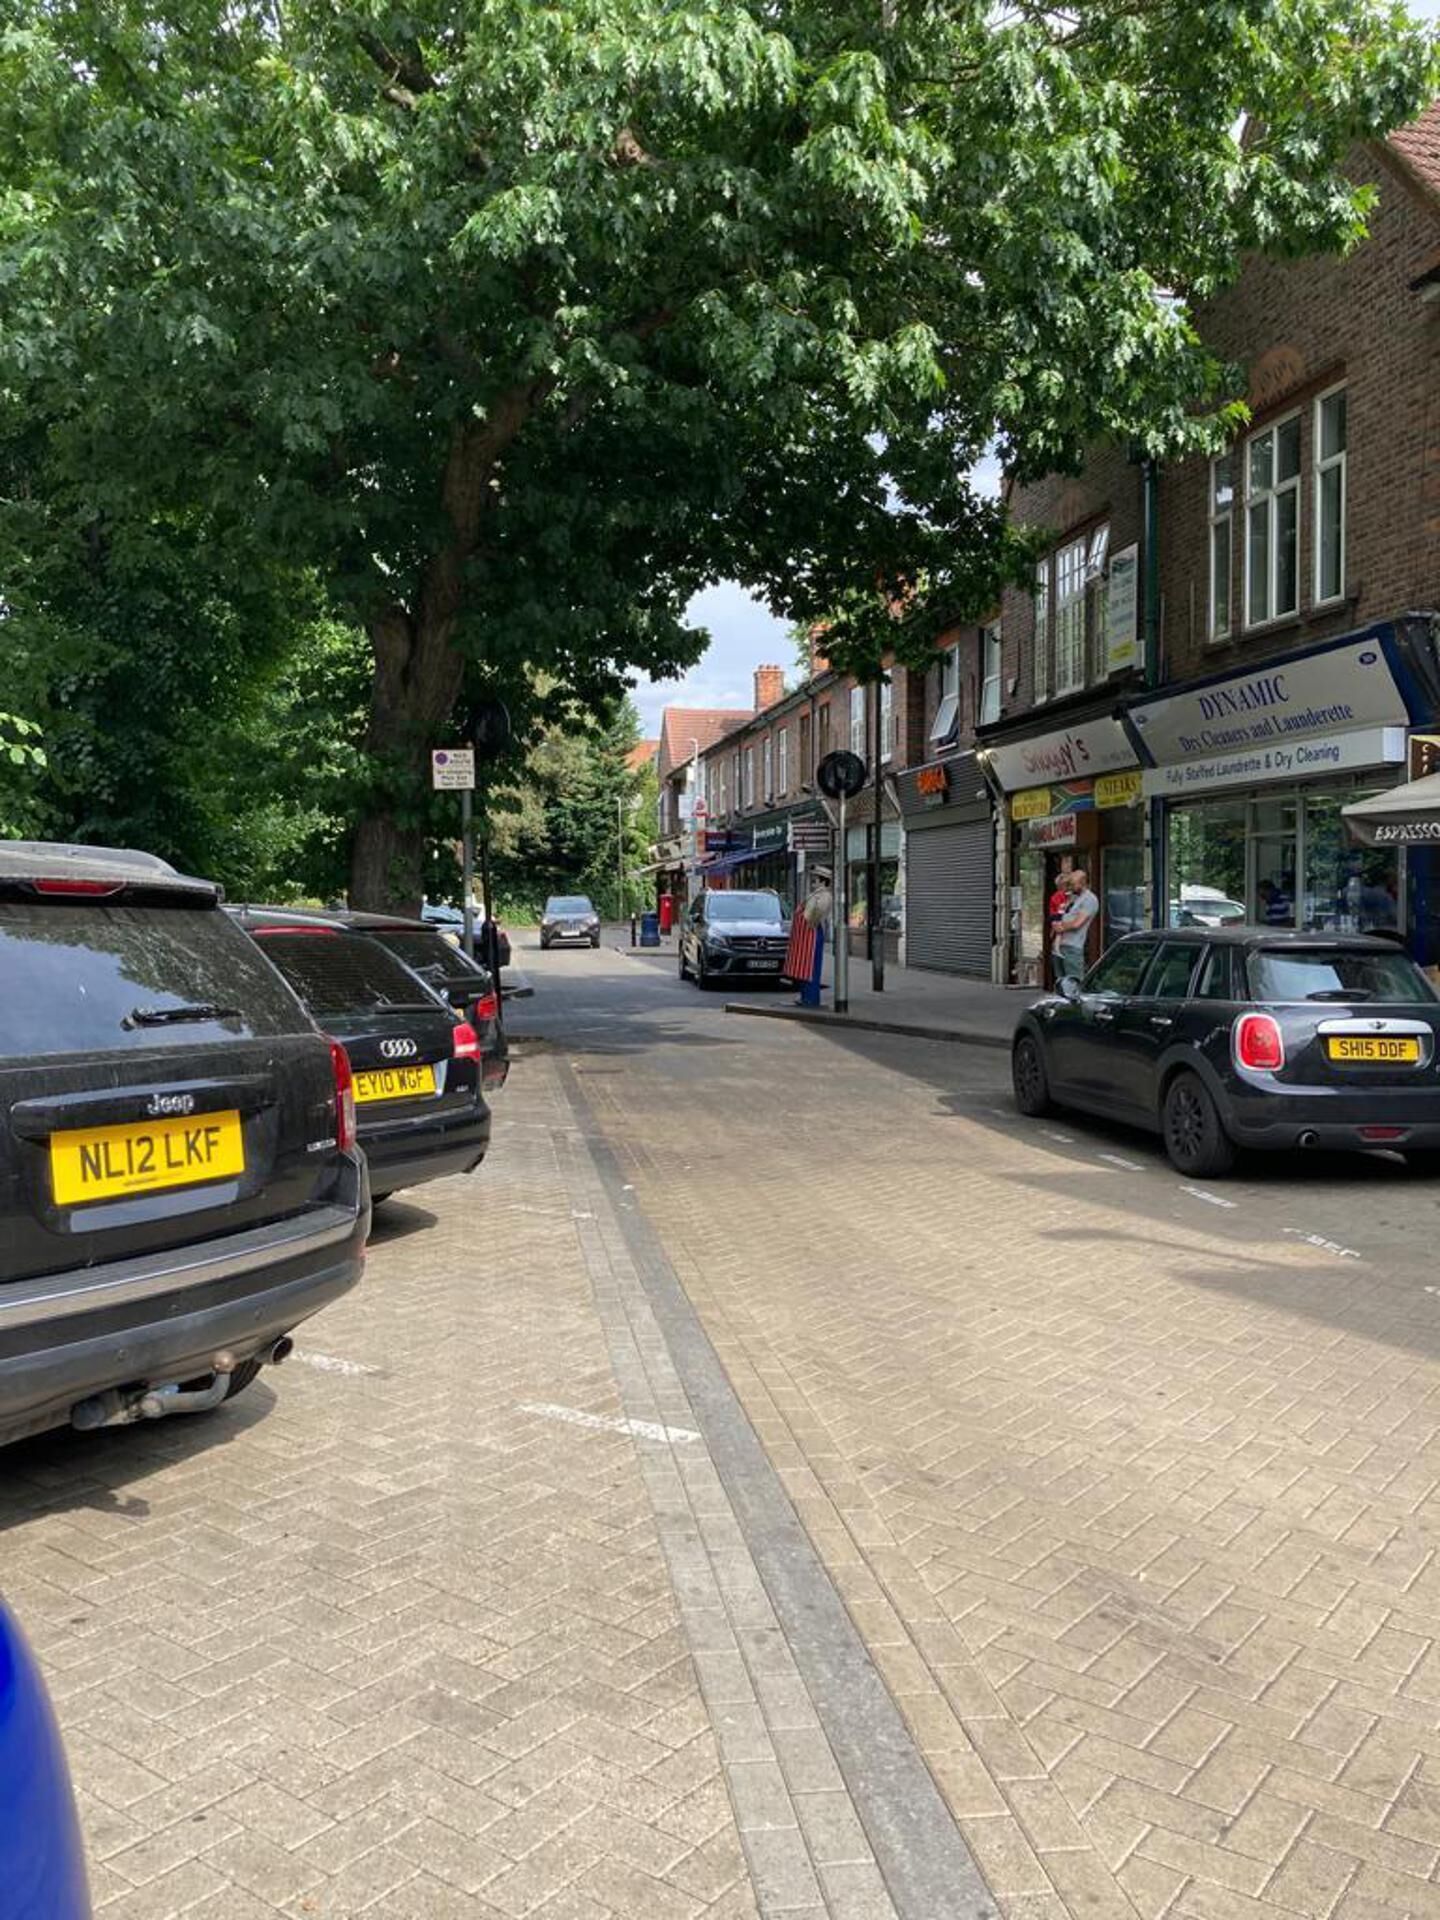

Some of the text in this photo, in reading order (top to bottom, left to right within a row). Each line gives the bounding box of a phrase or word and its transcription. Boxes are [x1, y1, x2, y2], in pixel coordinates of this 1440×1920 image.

[1200, 674, 1289, 720] DYNAMIC
[1201, 728, 1251, 749] Cleaners
[1250, 717, 1275, 738] and
[1272, 703, 1353, 736] Launderette
[1186, 763, 1216, 781] Staffed
[1265, 752, 1271, 769] &
[1274, 750, 1293, 769] Dry
[1296, 743, 1340, 764] Cleaning
[1374, 822, 1440, 842] ESPRESSO
[1338, 1040, 1373, 1057] SH15
[357, 1067, 425, 1096] EY10 WGF
[147, 1094, 195, 1115] Jeep
[79, 1127, 221, 1183] NL12 LKF
